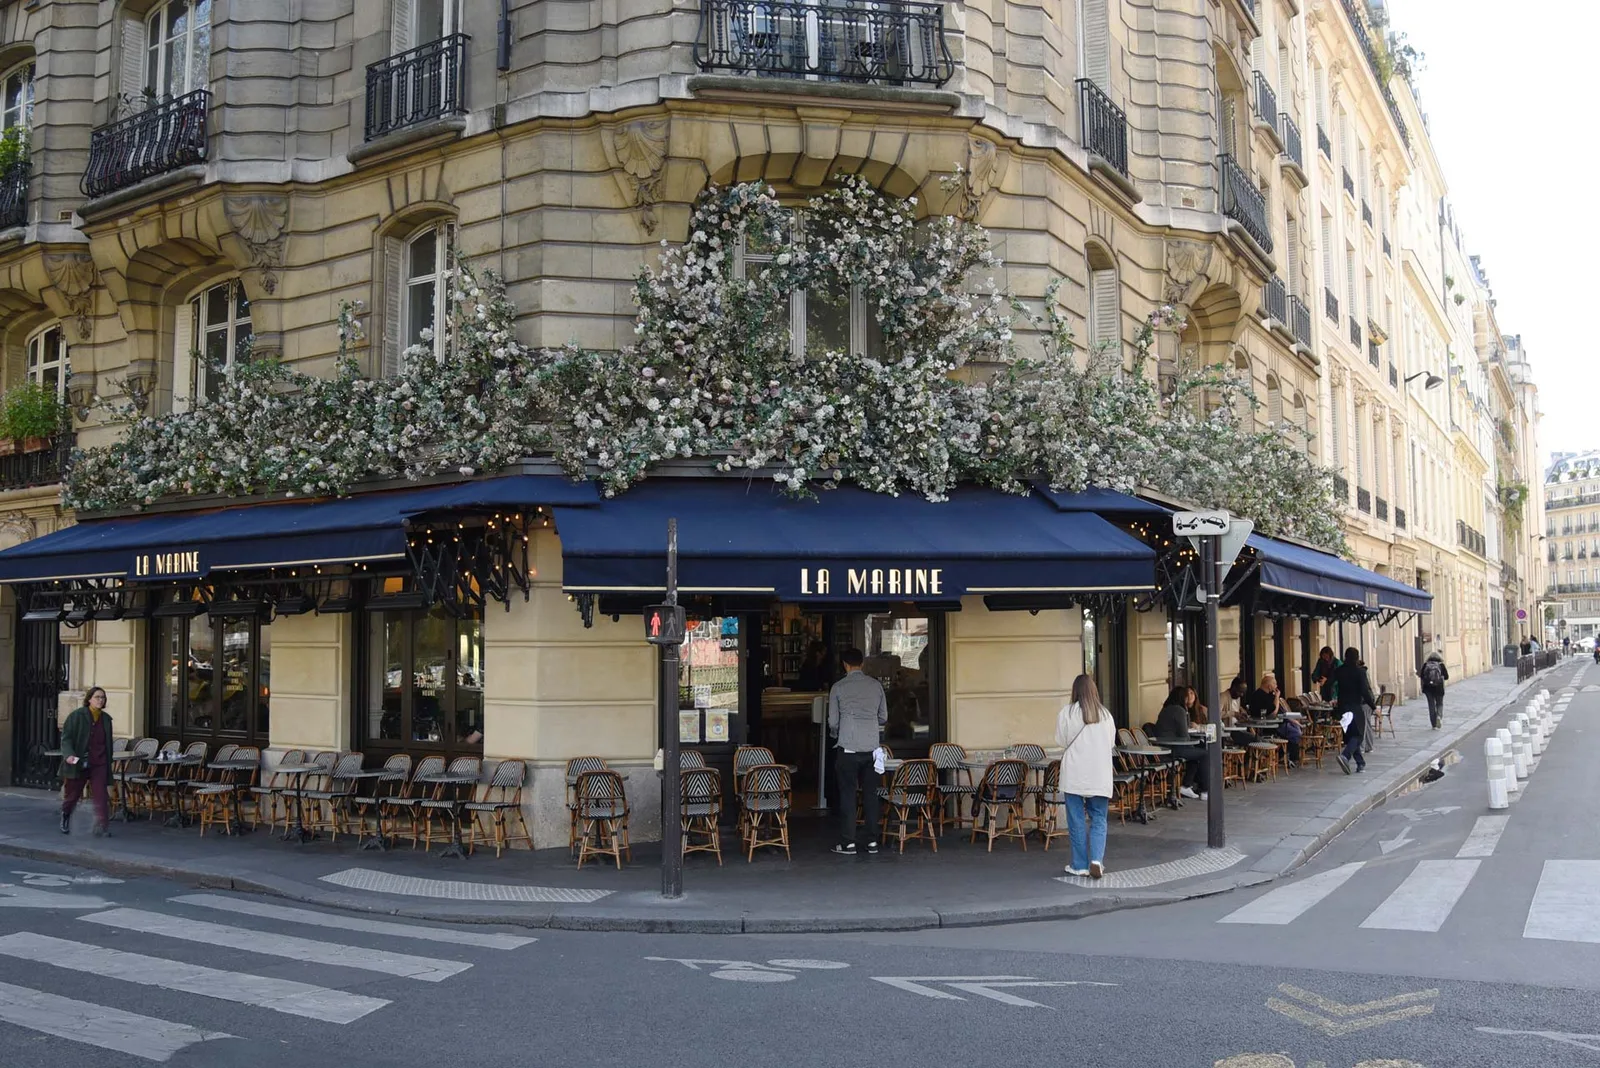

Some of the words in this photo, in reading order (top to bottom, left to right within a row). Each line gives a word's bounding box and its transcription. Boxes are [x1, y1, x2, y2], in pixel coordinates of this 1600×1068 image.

[136, 555, 150, 576] LA
[155, 551, 199, 574] MARINE
[801, 568, 830, 594] LA
[848, 568, 943, 594] MARINE
